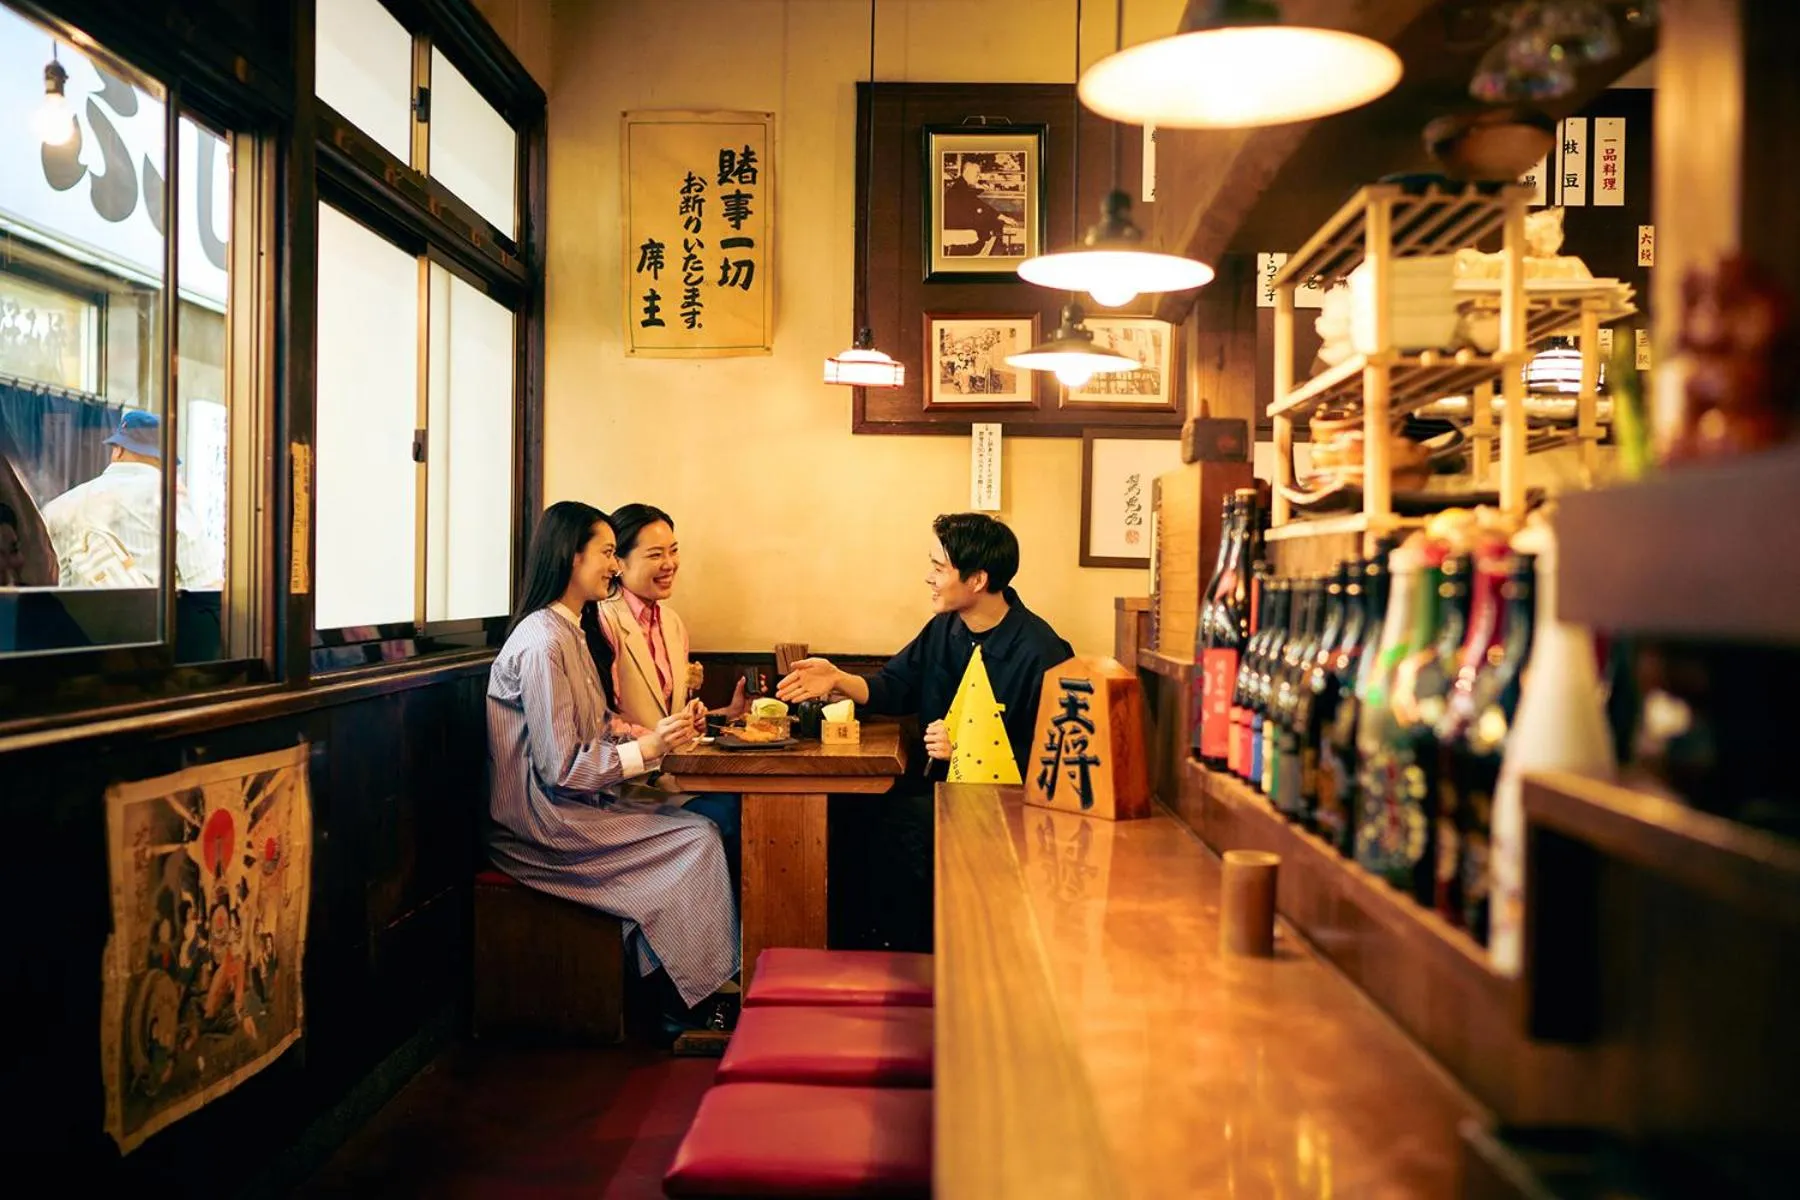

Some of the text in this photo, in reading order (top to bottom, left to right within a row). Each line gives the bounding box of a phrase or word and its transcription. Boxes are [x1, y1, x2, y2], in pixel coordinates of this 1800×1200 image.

[1563, 139, 1579, 188] 枝豆
[1603, 138, 1617, 191] 一品料理
[716, 144, 758, 291] 賭事一切
[1640, 233, 1652, 261] 六段
[636, 238, 666, 329] 席主
[1036, 677, 1101, 811] 王将
